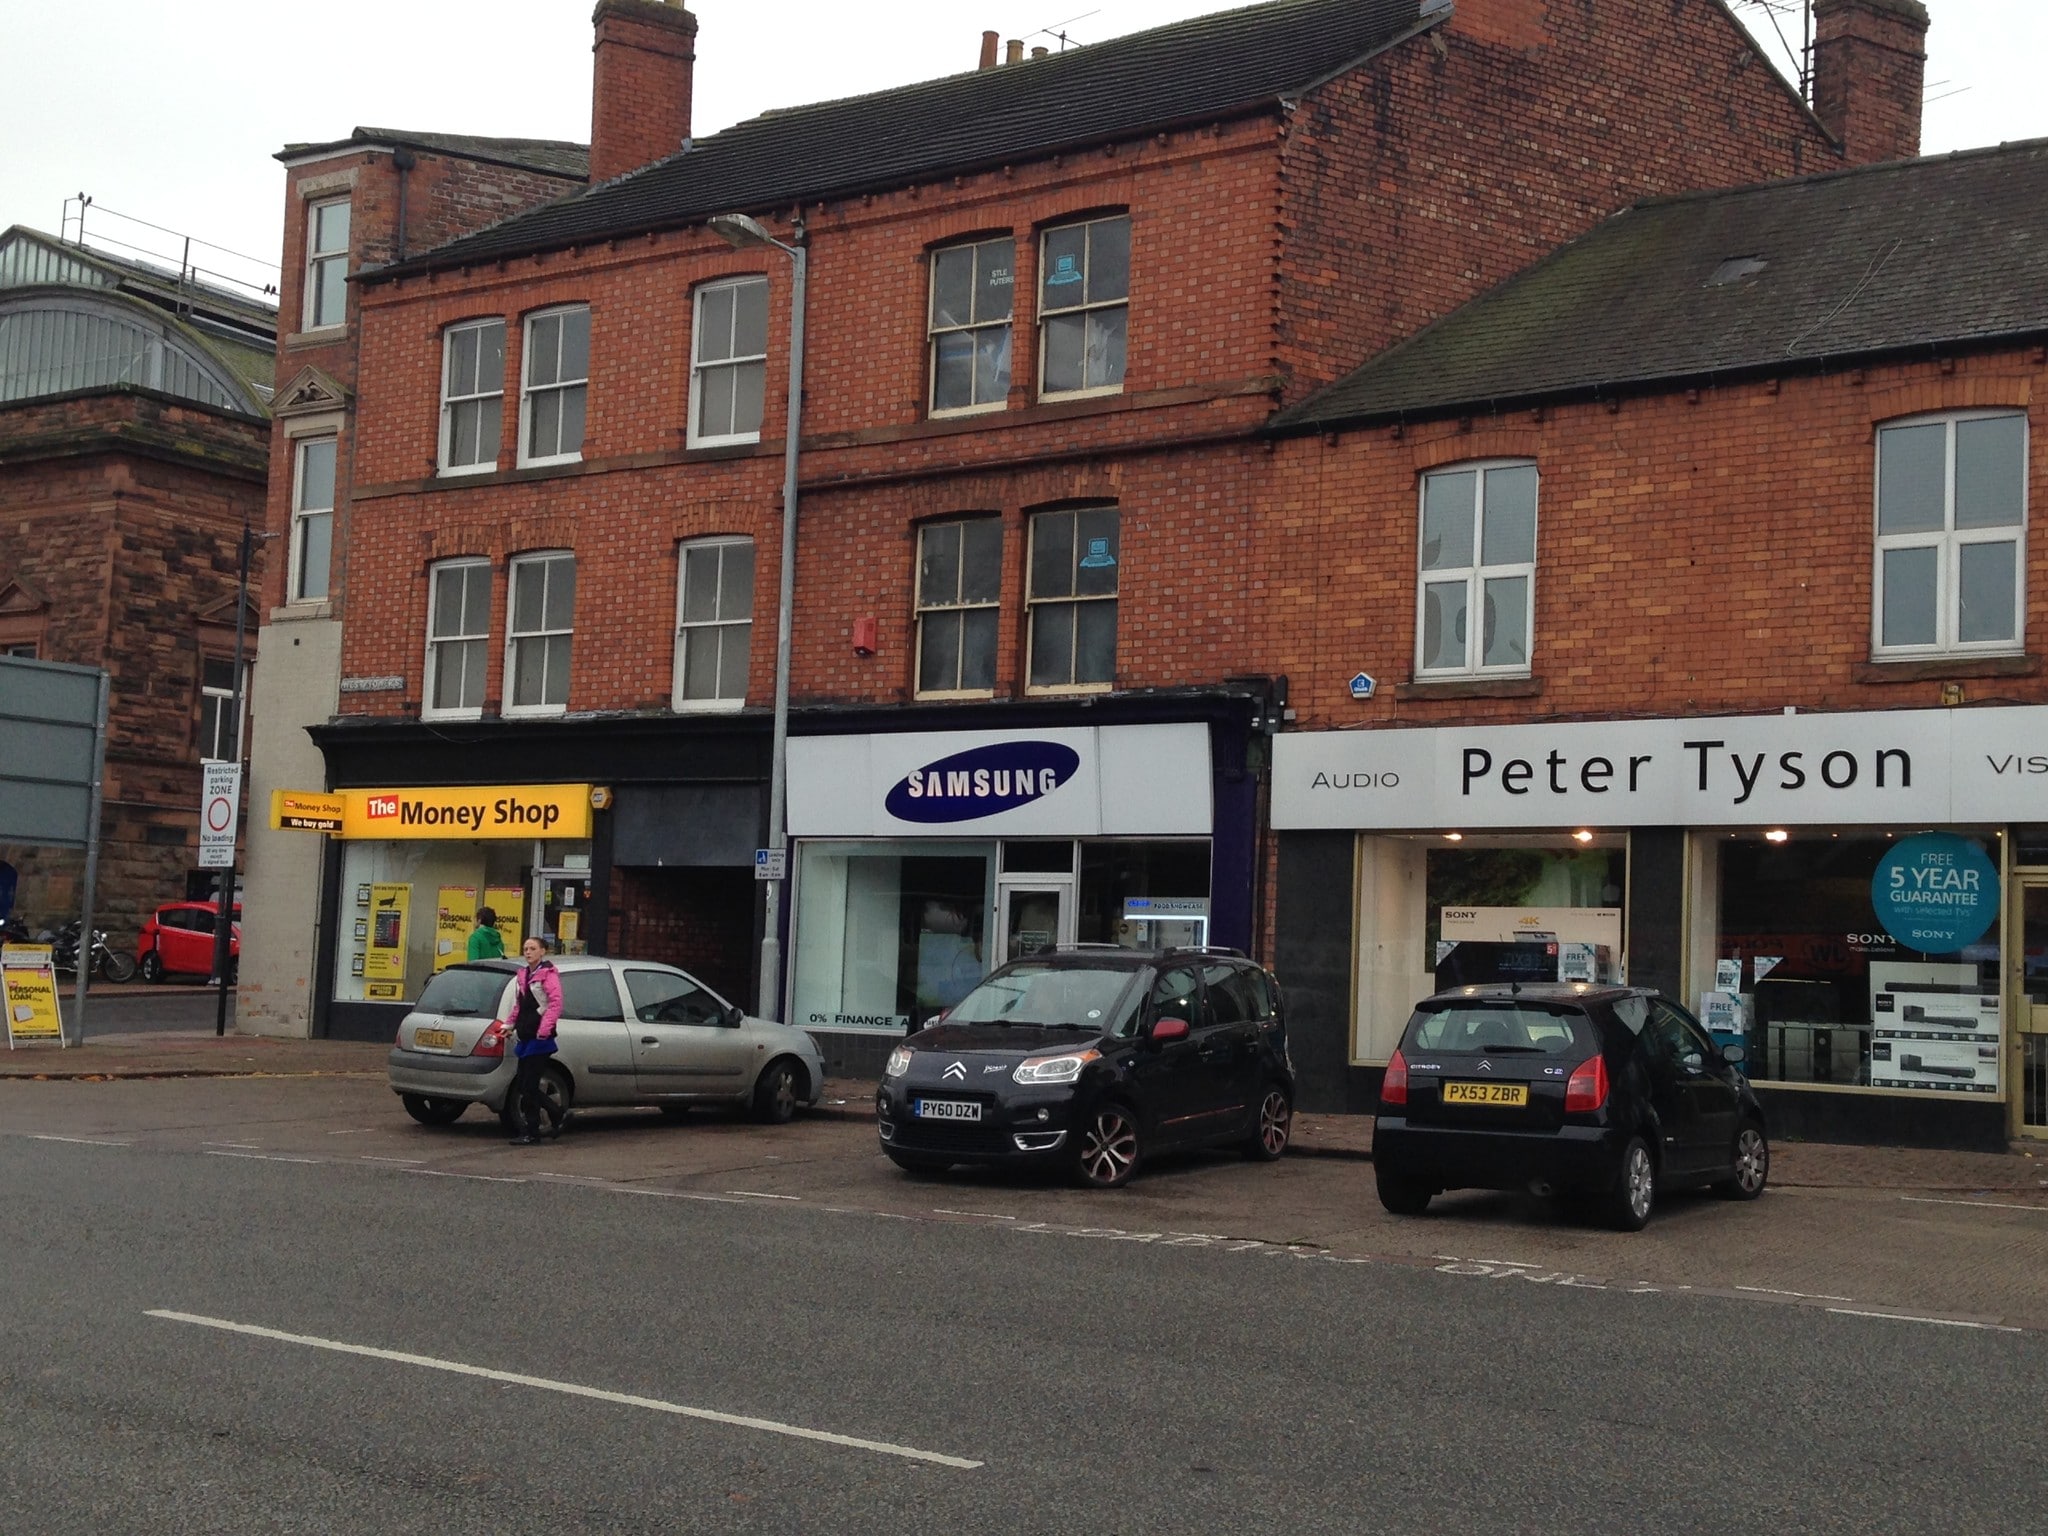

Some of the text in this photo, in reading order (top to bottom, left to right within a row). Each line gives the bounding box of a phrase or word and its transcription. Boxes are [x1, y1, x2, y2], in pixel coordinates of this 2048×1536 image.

[1461, 740, 1912, 805] Peter Tyson
[210, 776, 233, 784] parking
[908, 768, 1056, 798] SAMSUNG
[1311, 771, 1400, 789] AUDIO
[209, 785, 232, 795] ZONE
[295, 802, 321, 813] Money
[322, 803, 342, 814] Shop
[368, 798, 560, 831] The Money Shop
[290, 818, 334, 830] We buy gold
[202, 834, 233, 843] No loading
[1920, 853, 1954, 866] FREE
[1889, 866, 1980, 891] 5 YEAR
[1889, 890, 1978, 906] GUARANTEE
[1445, 911, 1477, 919] SONY
[1894, 905, 1914, 915] with
[1915, 905, 1951, 916] selected
[1518, 916, 1540, 926] 4K
[1846, 933, 1897, 944] SONY
[1911, 929, 1955, 940] SONY
[1566, 953, 1586, 961] FREE
[1710, 1002, 1733, 1012] FREE
[809, 1013, 827, 1023] 0%
[834, 1014, 893, 1026] FINANCE
[1449, 1085, 1521, 1102] PX53 ZBR
[922, 1102, 952, 1117] PY60
